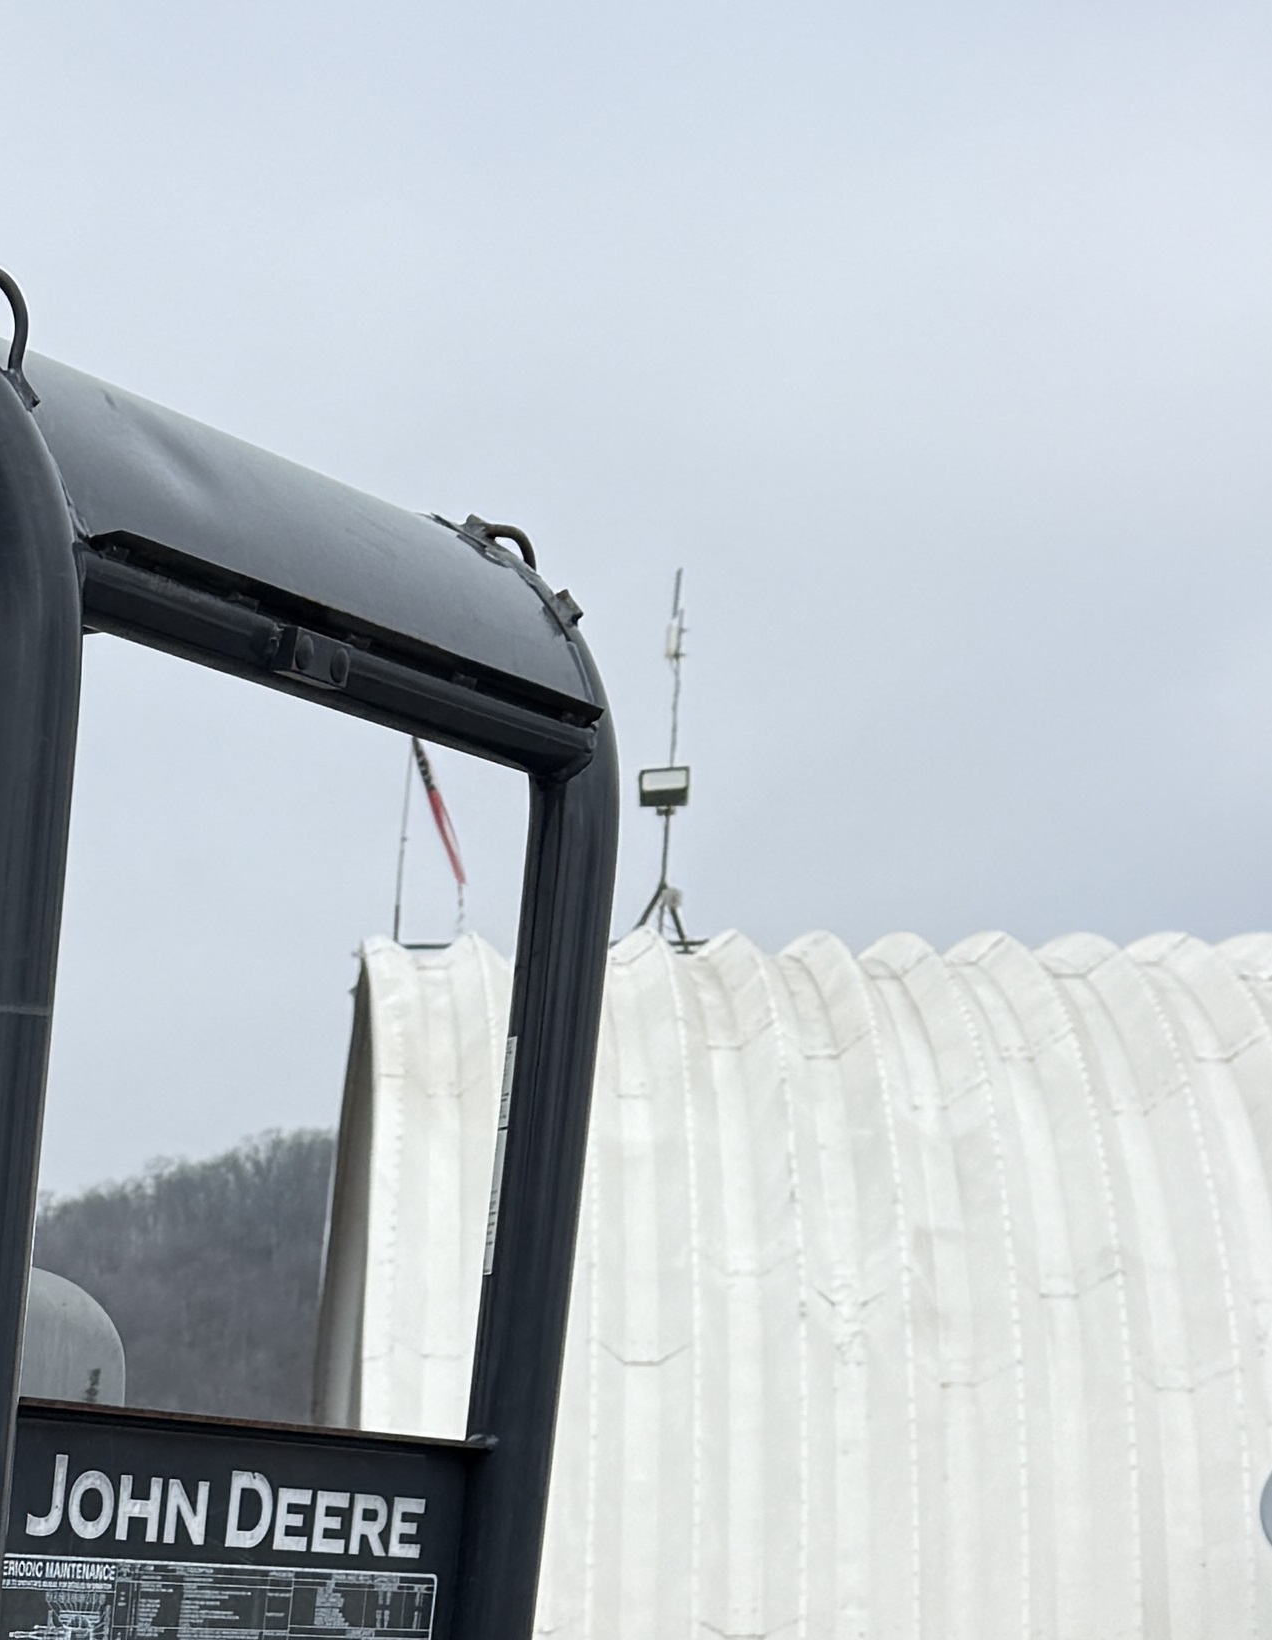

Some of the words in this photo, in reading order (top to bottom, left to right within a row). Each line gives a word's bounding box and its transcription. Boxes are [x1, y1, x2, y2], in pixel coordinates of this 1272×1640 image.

[26, 1454, 210, 1545] JOHN
[224, 1470, 426, 1559] DEERE
[2, 1560, 44, 1578] ERIODIC
[45, 1561, 116, 1581] MAINTENANCE
